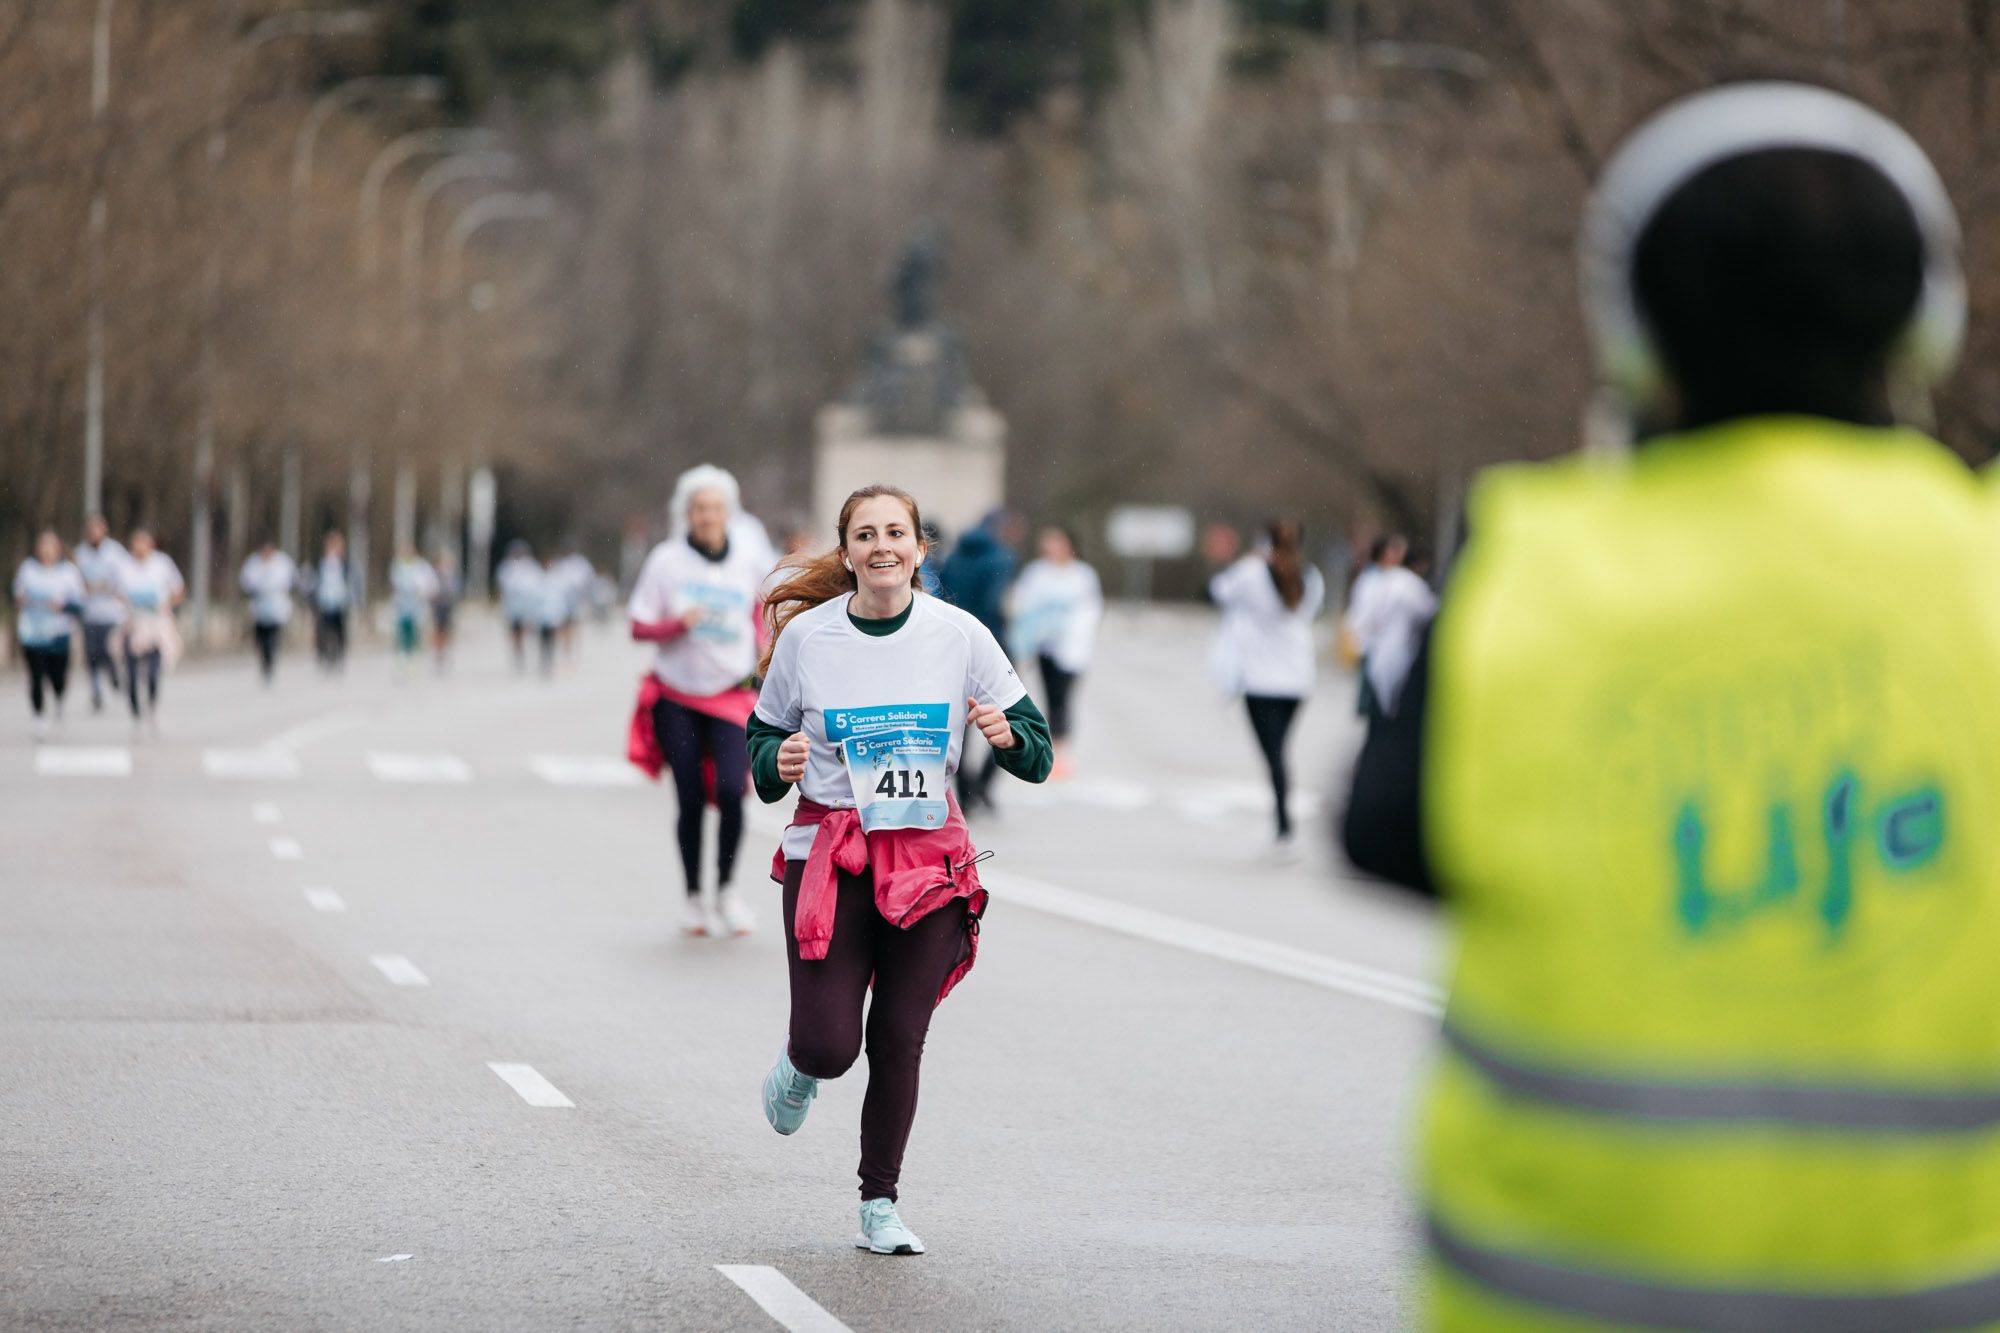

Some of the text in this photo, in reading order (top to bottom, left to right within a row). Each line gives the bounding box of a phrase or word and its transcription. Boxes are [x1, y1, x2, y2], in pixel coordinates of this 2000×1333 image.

[850, 714, 885, 724] Carrera
[888, 711, 928, 721] Solidaria
[869, 738, 901, 749] Carrera
[875, 769, 928, 798] 412
